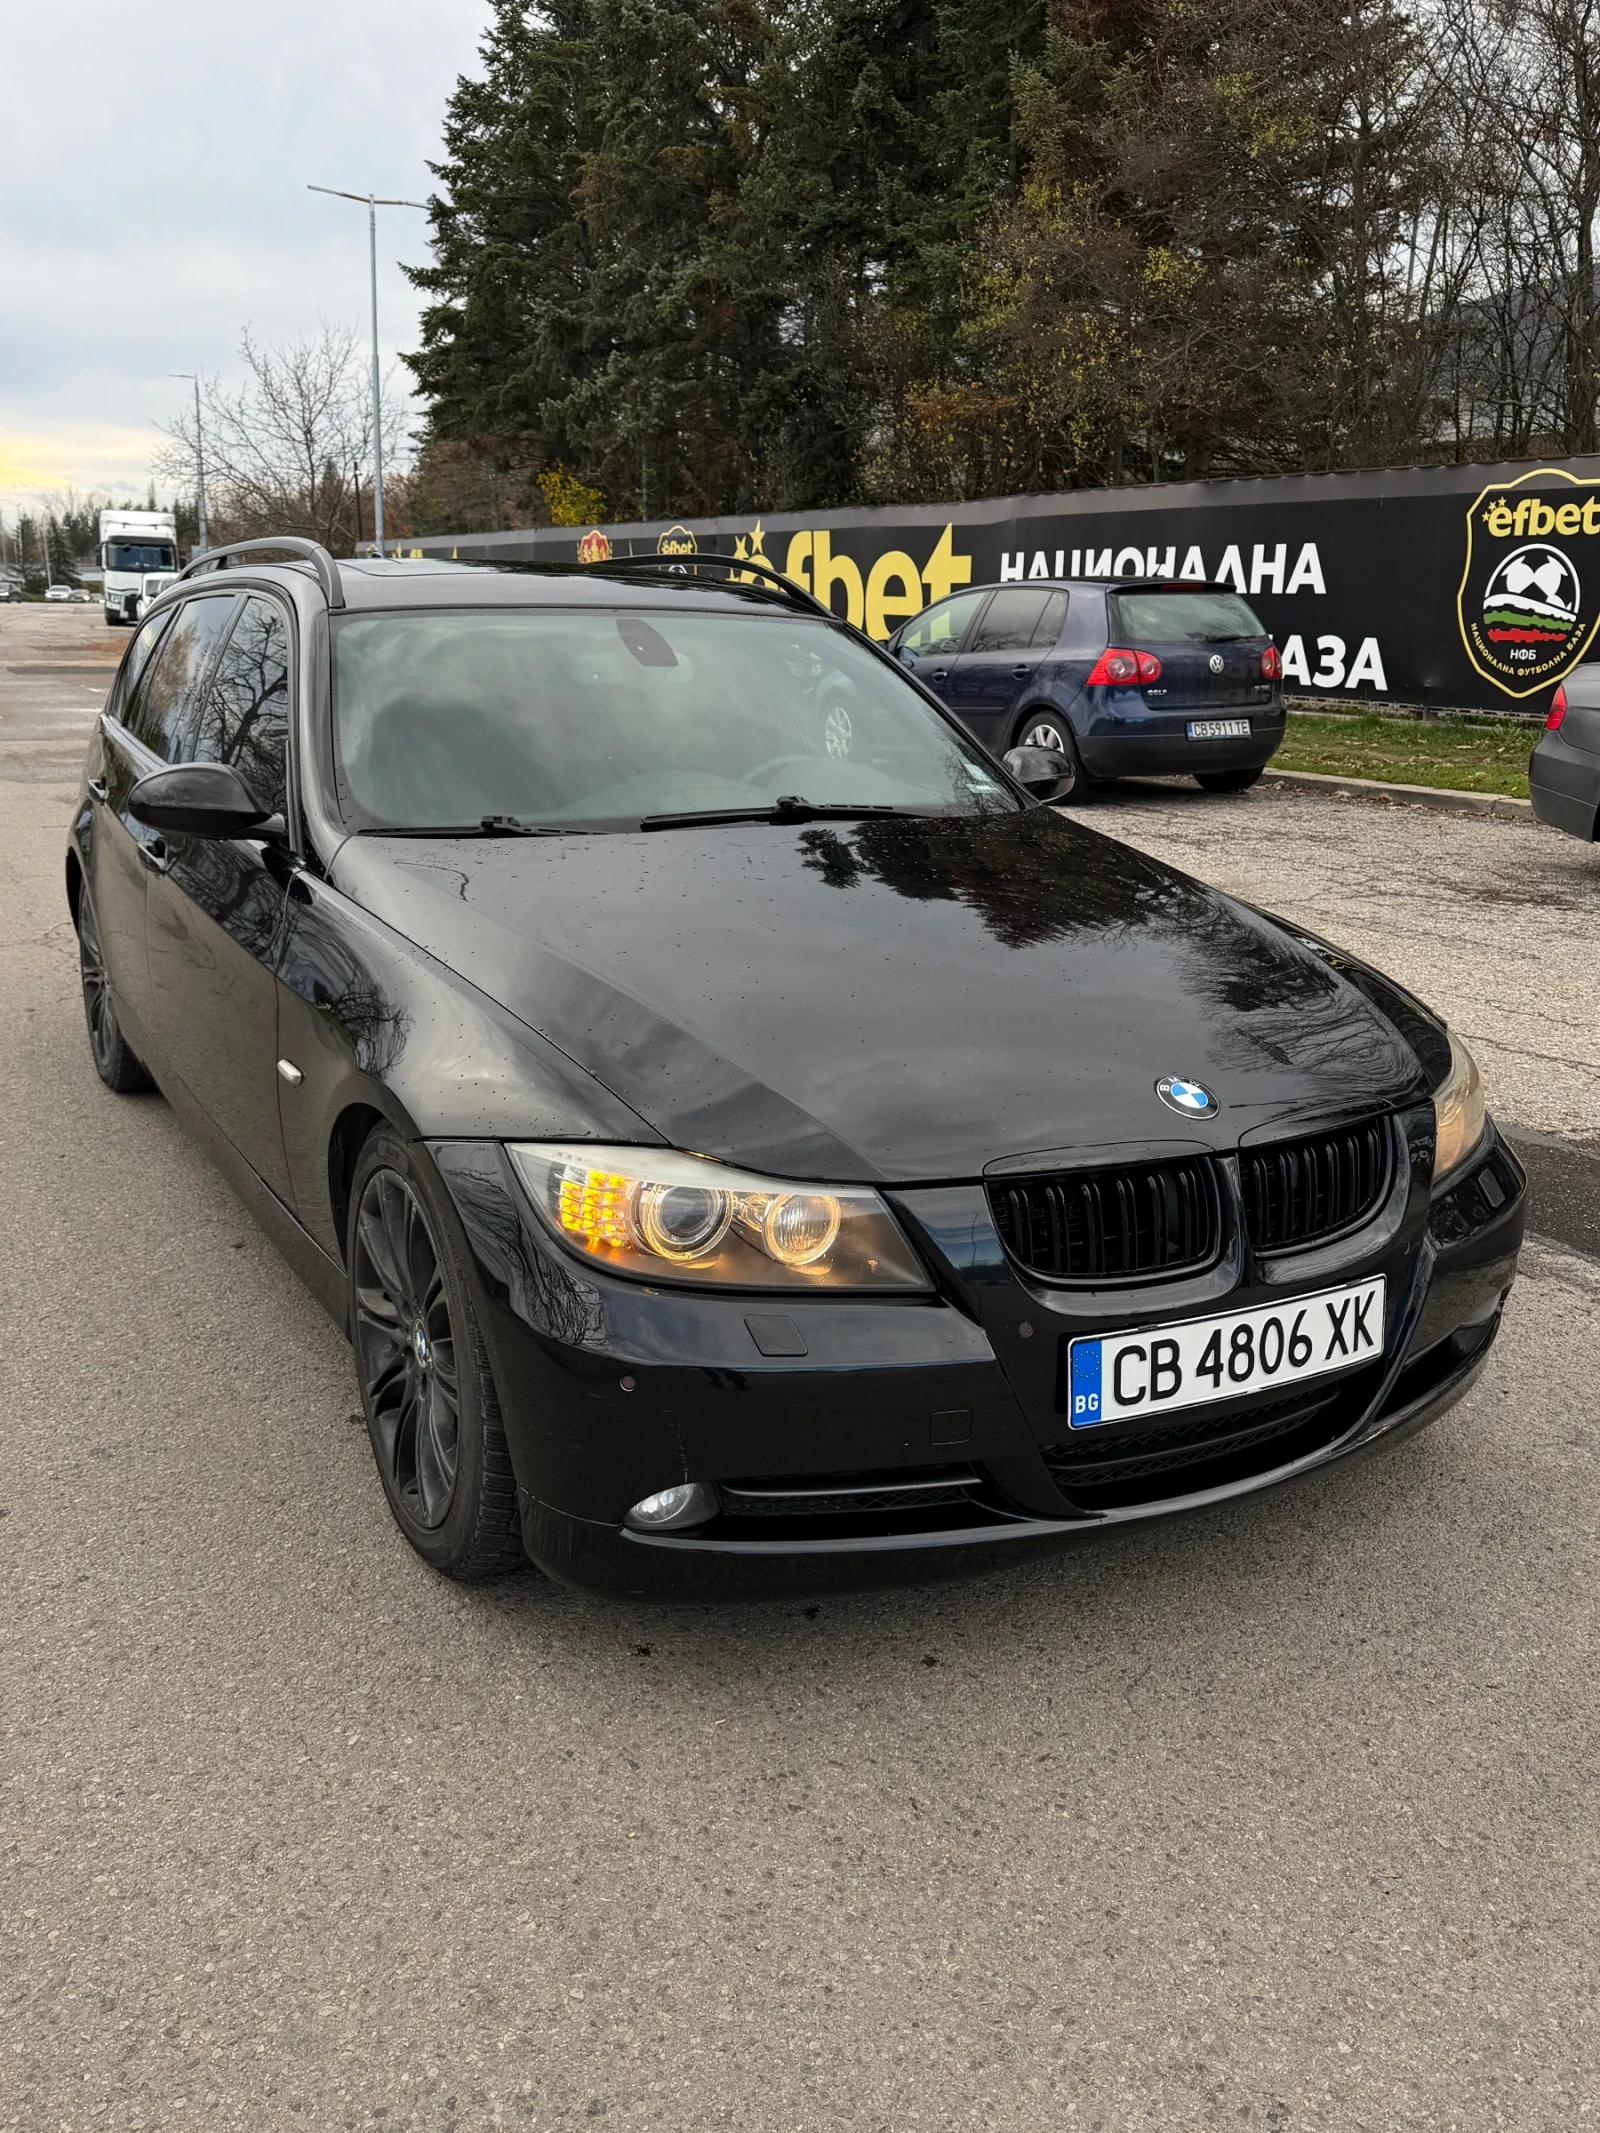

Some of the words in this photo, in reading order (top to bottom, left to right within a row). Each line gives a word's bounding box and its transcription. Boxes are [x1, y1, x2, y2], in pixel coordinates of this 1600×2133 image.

[1488, 496, 1600, 537] efbet
[1001, 543, 1326, 594] НАЦИОНАЛНА
[1268, 634, 1388, 691] АЗА
[1510, 649, 1537, 660] НФБ
[1113, 1338, 1183, 1407] CB
[1194, 1308, 1314, 1389] 4806
[1324, 1290, 1377, 1361] XK
[1075, 1393, 1099, 1414] BG
